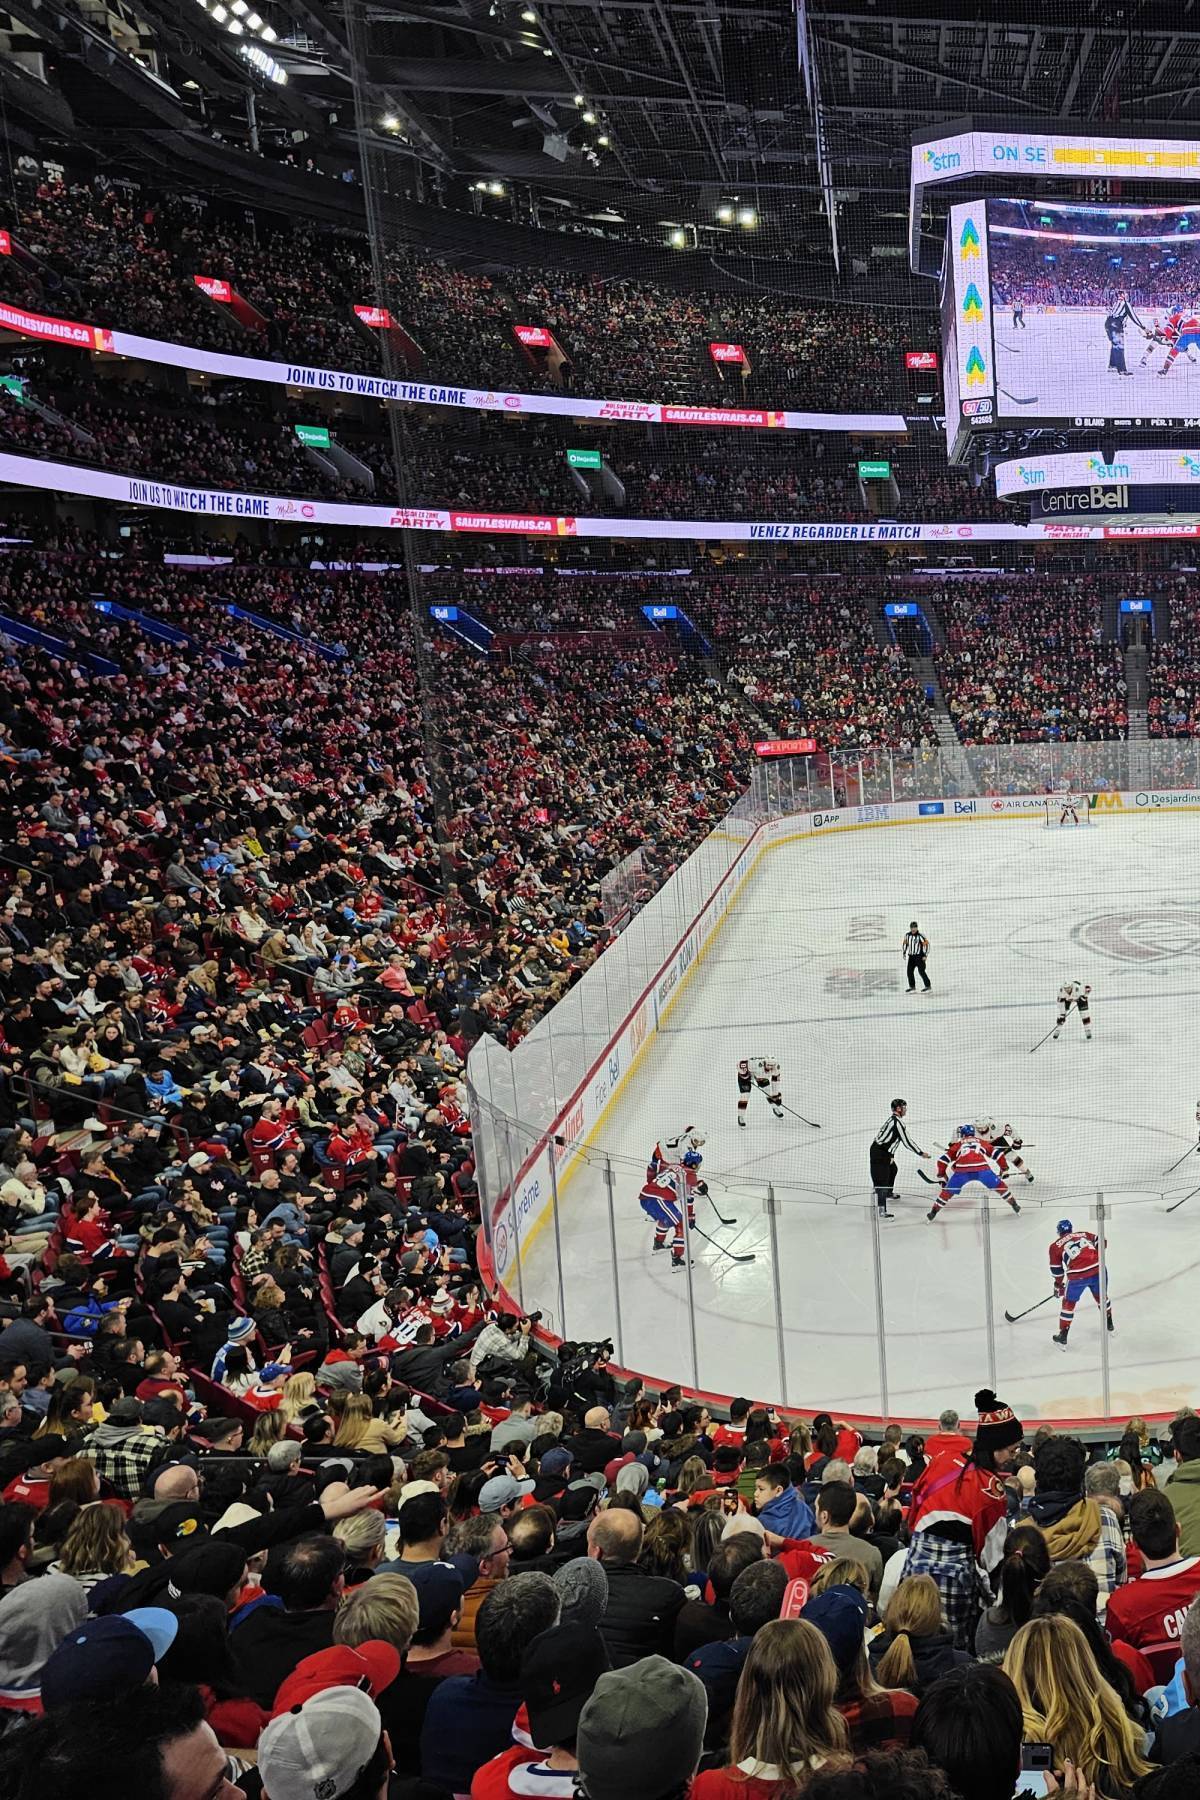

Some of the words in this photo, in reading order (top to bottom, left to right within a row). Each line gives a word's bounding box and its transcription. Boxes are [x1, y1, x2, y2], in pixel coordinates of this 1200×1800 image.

[993, 145, 1019, 161] ON
[1025, 147, 1047, 162] SE
[933, 153, 960, 172] stm
[287, 367, 315, 386] JOIN
[318, 372, 335, 389] US
[340, 375, 354, 392] TO
[357, 378, 398, 398] WATCH
[401, 386, 426, 401] THE
[430, 390, 467, 405] GAME
[599, 409, 655, 420] PARTY
[665, 408, 763, 424] SALUTLESVRAIS.CA
[1084, 417, 1105, 427] BLANC
[1023, 468, 1046, 485] stm
[1098, 462, 1129, 479] stm
[129, 481, 149, 502] JOIN
[149, 487, 161, 506] US
[162, 490, 173, 508] TO
[174, 491, 207, 512] WATCH
[209, 495, 233, 513] THE
[236, 498, 270, 517] GAME
[1041, 485, 1129, 511] CentreBell
[390, 517, 446, 528] PARTY
[455, 516, 552, 532] SALUTLESVRAIS.CA
[749, 526, 790, 538] VENEZ
[791, 526, 858, 539] REGARDER
[860, 527, 876, 539] LE
[878, 526, 921, 539] MATCH
[653, 607, 667, 617] Bell
[894, 605, 908, 614] Bell
[1129, 600, 1143, 610] Bell
[954, 801, 977, 814] Bell
[1006, 800, 1018, 809] AIR
